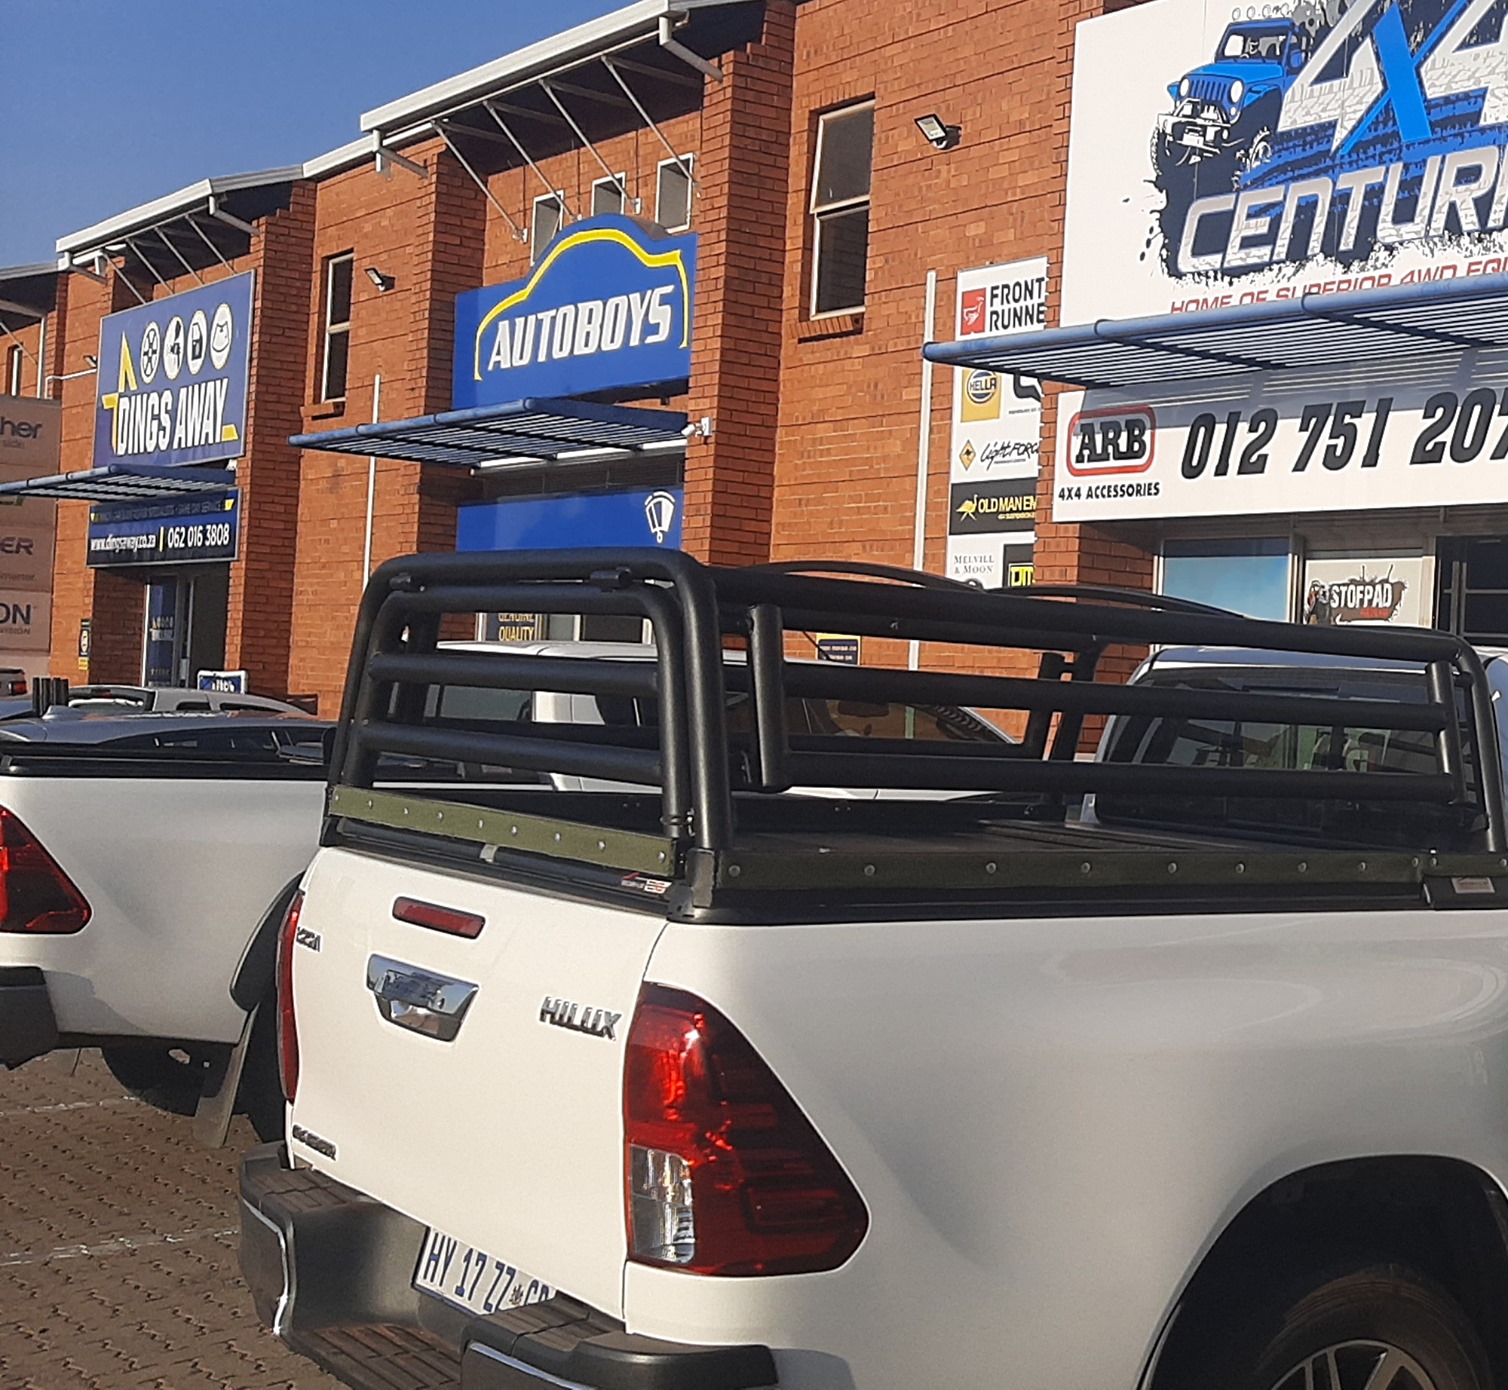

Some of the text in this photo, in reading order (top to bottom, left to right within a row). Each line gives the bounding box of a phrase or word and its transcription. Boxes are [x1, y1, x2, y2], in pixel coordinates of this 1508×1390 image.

[990, 276, 1046, 308] FRONT
[487, 285, 675, 371] AUTOBOYS
[989, 302, 1046, 333] RUNNE
[969, 377, 997, 391] HELLA
[116, 377, 230, 457] DINGS AWAY
[1075, 417, 1147, 464] ARB
[1181, 407, 1280, 480] 012
[1291, 396, 1394, 474] 751
[978, 497, 999, 513] OLD
[999, 496, 1022, 512] MAN
[1058, 481, 1161, 502] 4X4 ACCESSORIES
[167, 523, 230, 549] 062 016 3808
[1330, 582, 1393, 609] STOFPAD
[538, 995, 622, 1042] HILUX
[422, 1231, 459, 1288] HY
[454, 1247, 488, 1302] 17
[482, 1259, 518, 1313] ZZ
